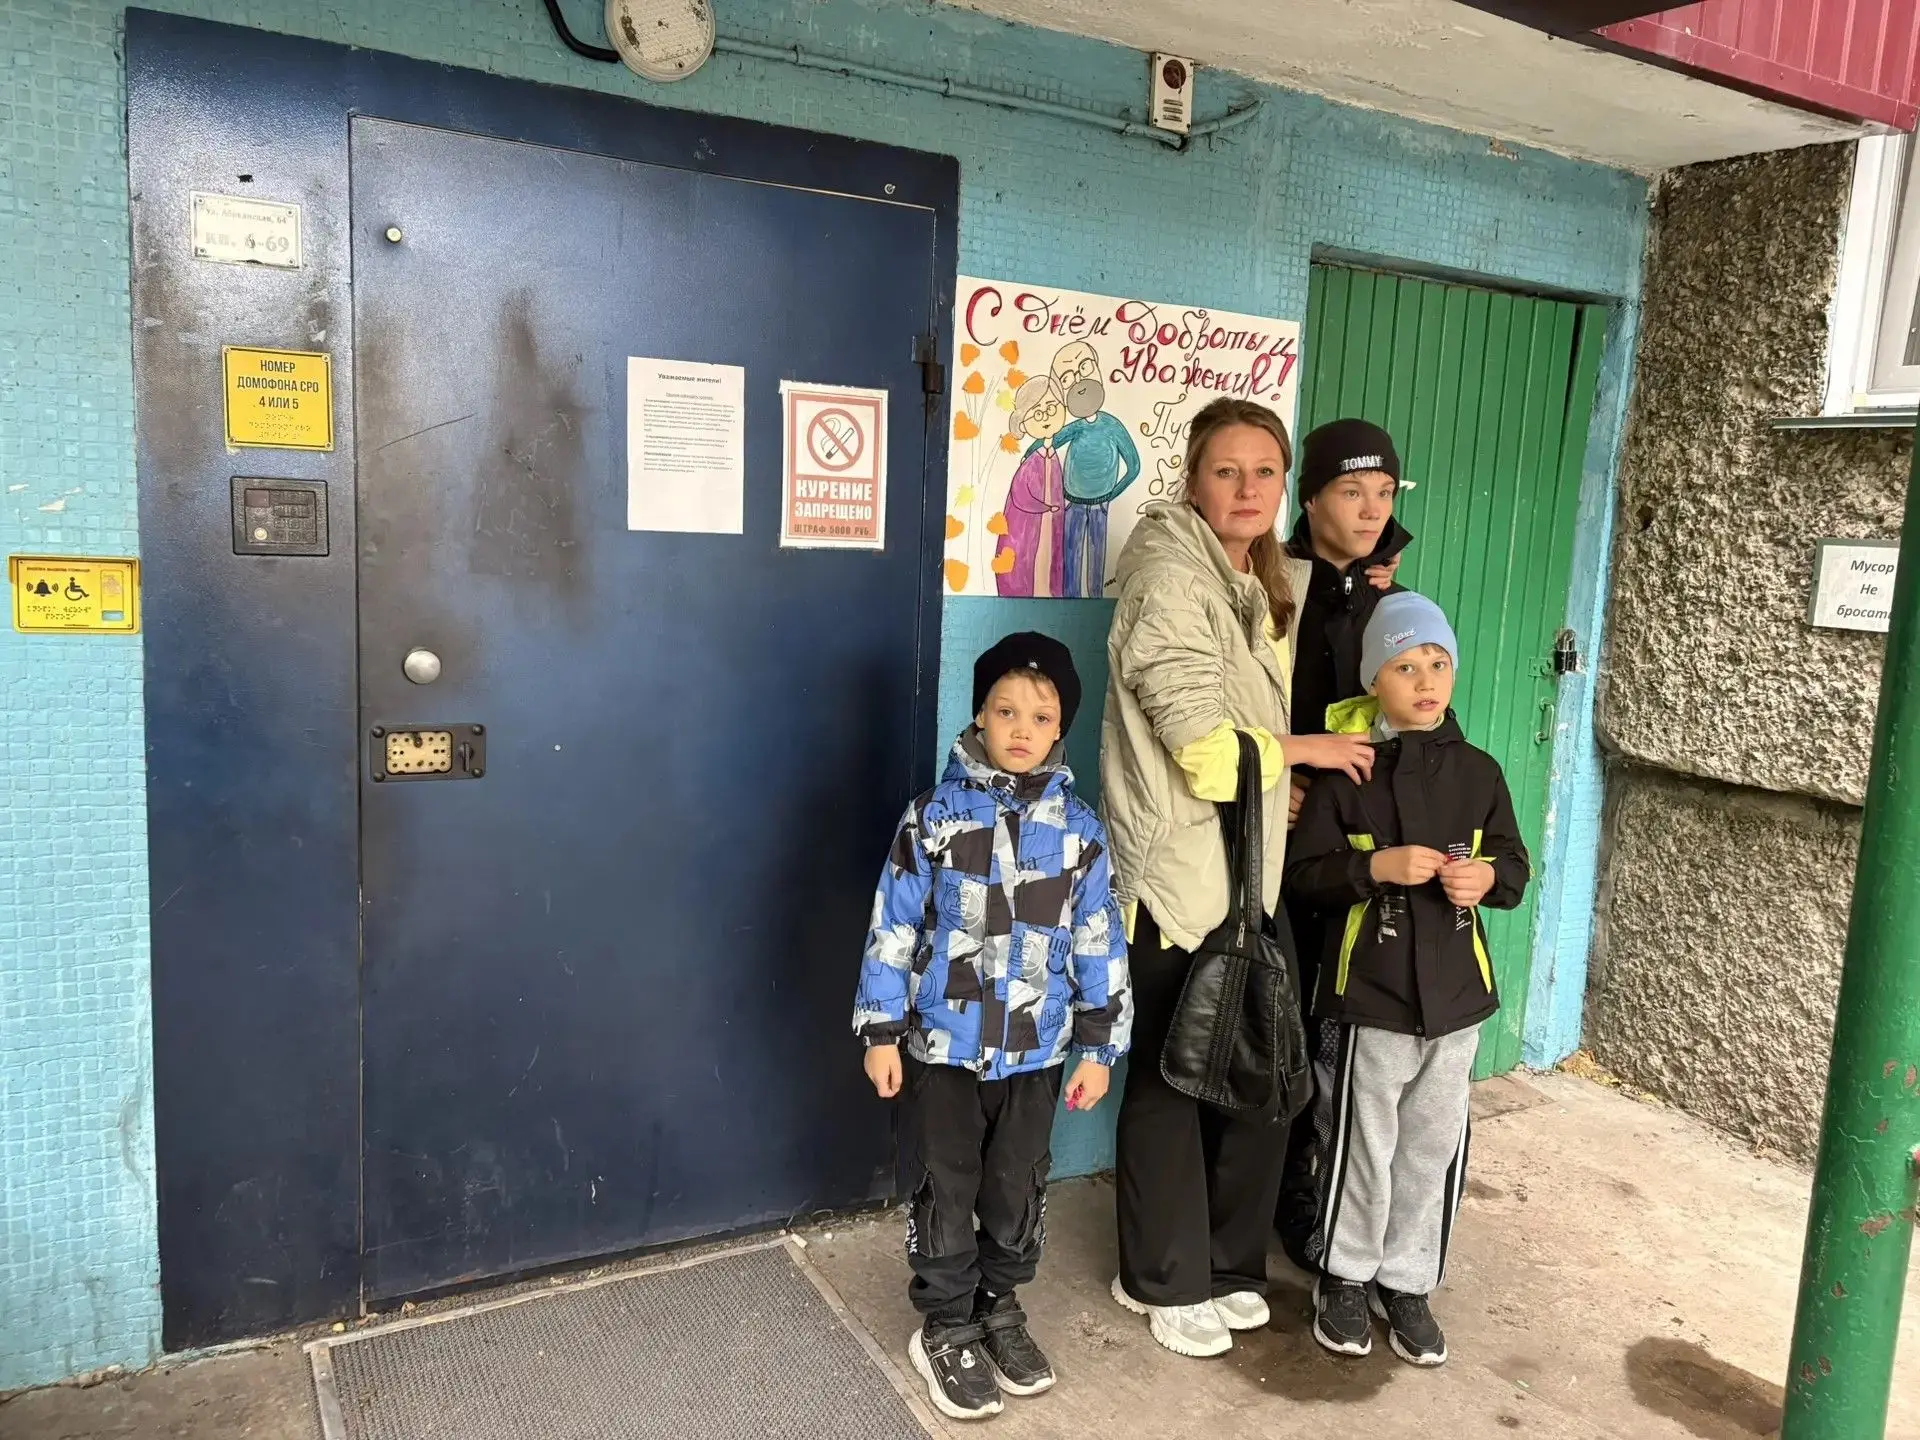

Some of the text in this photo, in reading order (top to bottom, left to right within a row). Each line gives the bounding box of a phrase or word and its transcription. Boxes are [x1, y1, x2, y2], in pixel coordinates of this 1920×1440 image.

[965, 286, 1003, 347] С
[260, 359, 296, 374] НОМЕР
[237, 375, 319, 393] ДОМОФОНА СРО
[258, 396, 299, 410] 4 ИЛИ 5
[1343, 455, 1381, 471] TOMMY
[795, 479, 873, 502] КУРЕНИЕ
[794, 501, 873, 522] ЗАПРЕЩЕНО
[794, 524, 826, 534] ШТРАФ
[1850, 560, 1894, 575] Мусор
[1860, 584, 1878, 596] Не
